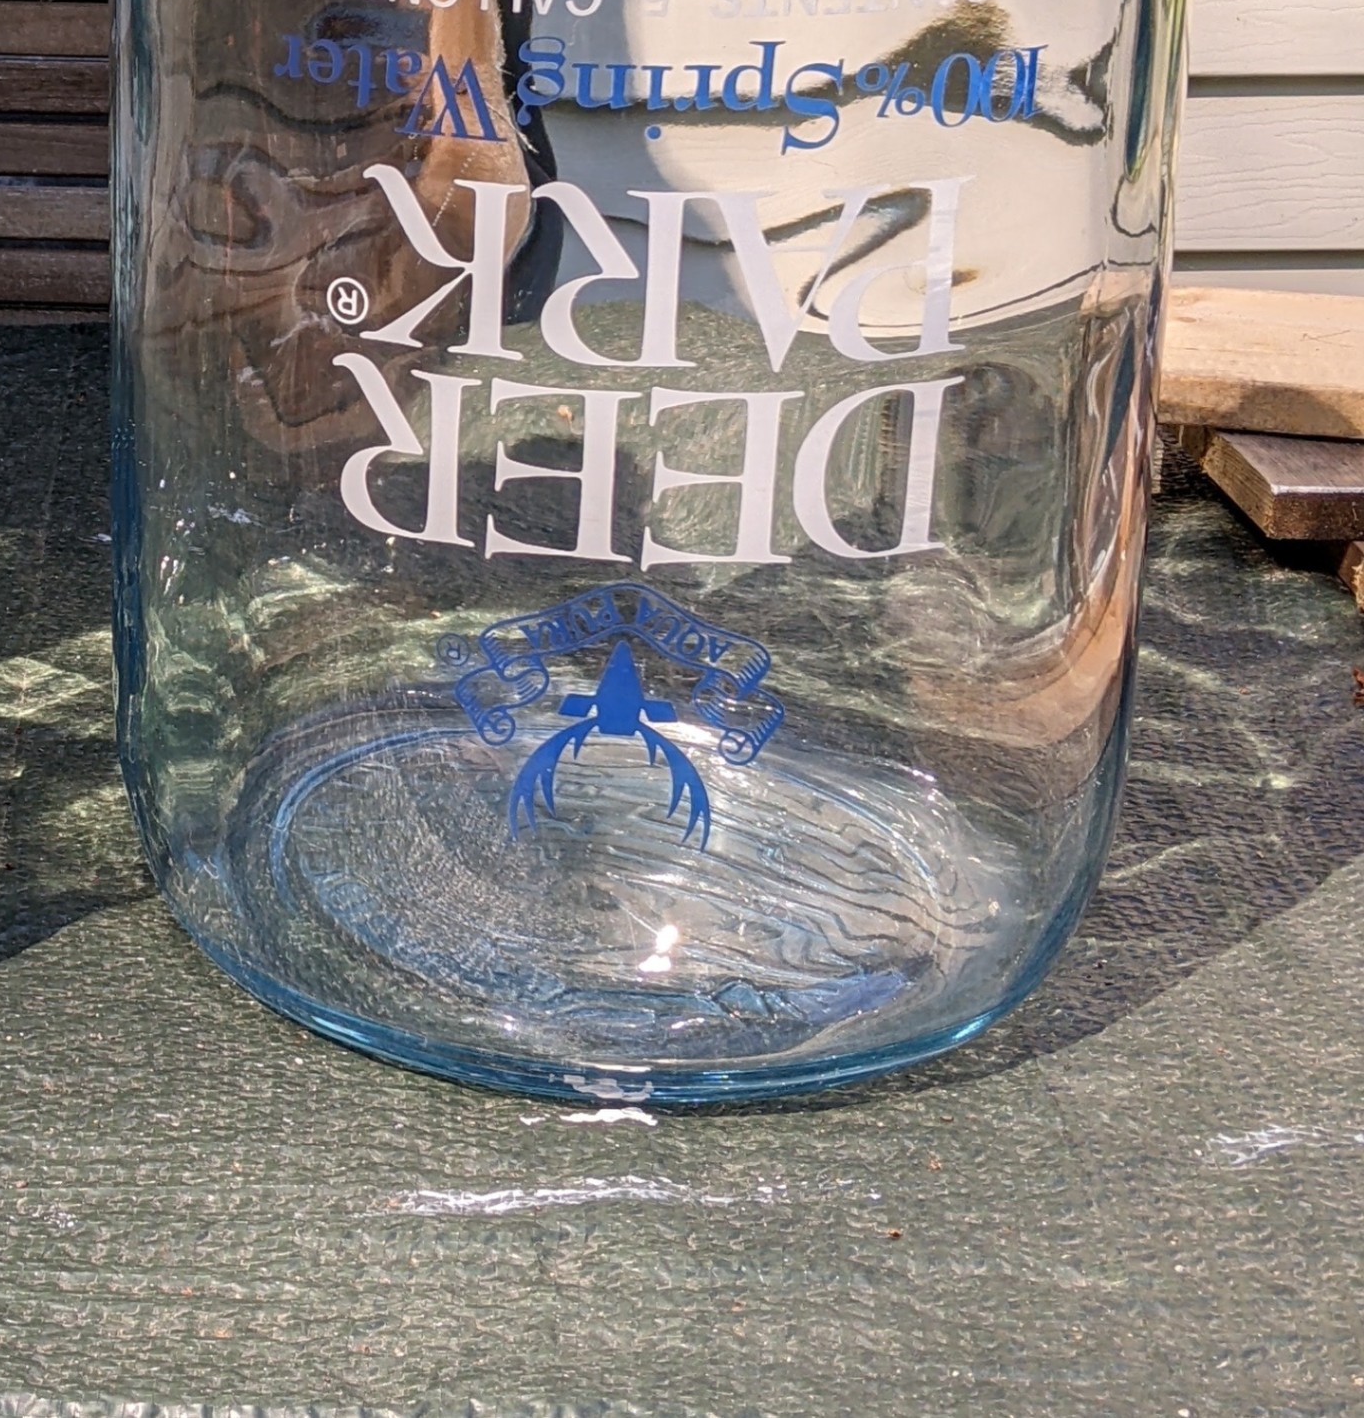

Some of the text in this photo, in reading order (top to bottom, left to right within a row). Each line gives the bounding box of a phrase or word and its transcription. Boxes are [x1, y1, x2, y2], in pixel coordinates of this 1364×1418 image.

[275, 33, 1049, 156] 100% Spring Water
[333, 352, 965, 572] DEER
[519, 592, 731, 663] AQUA PURA
